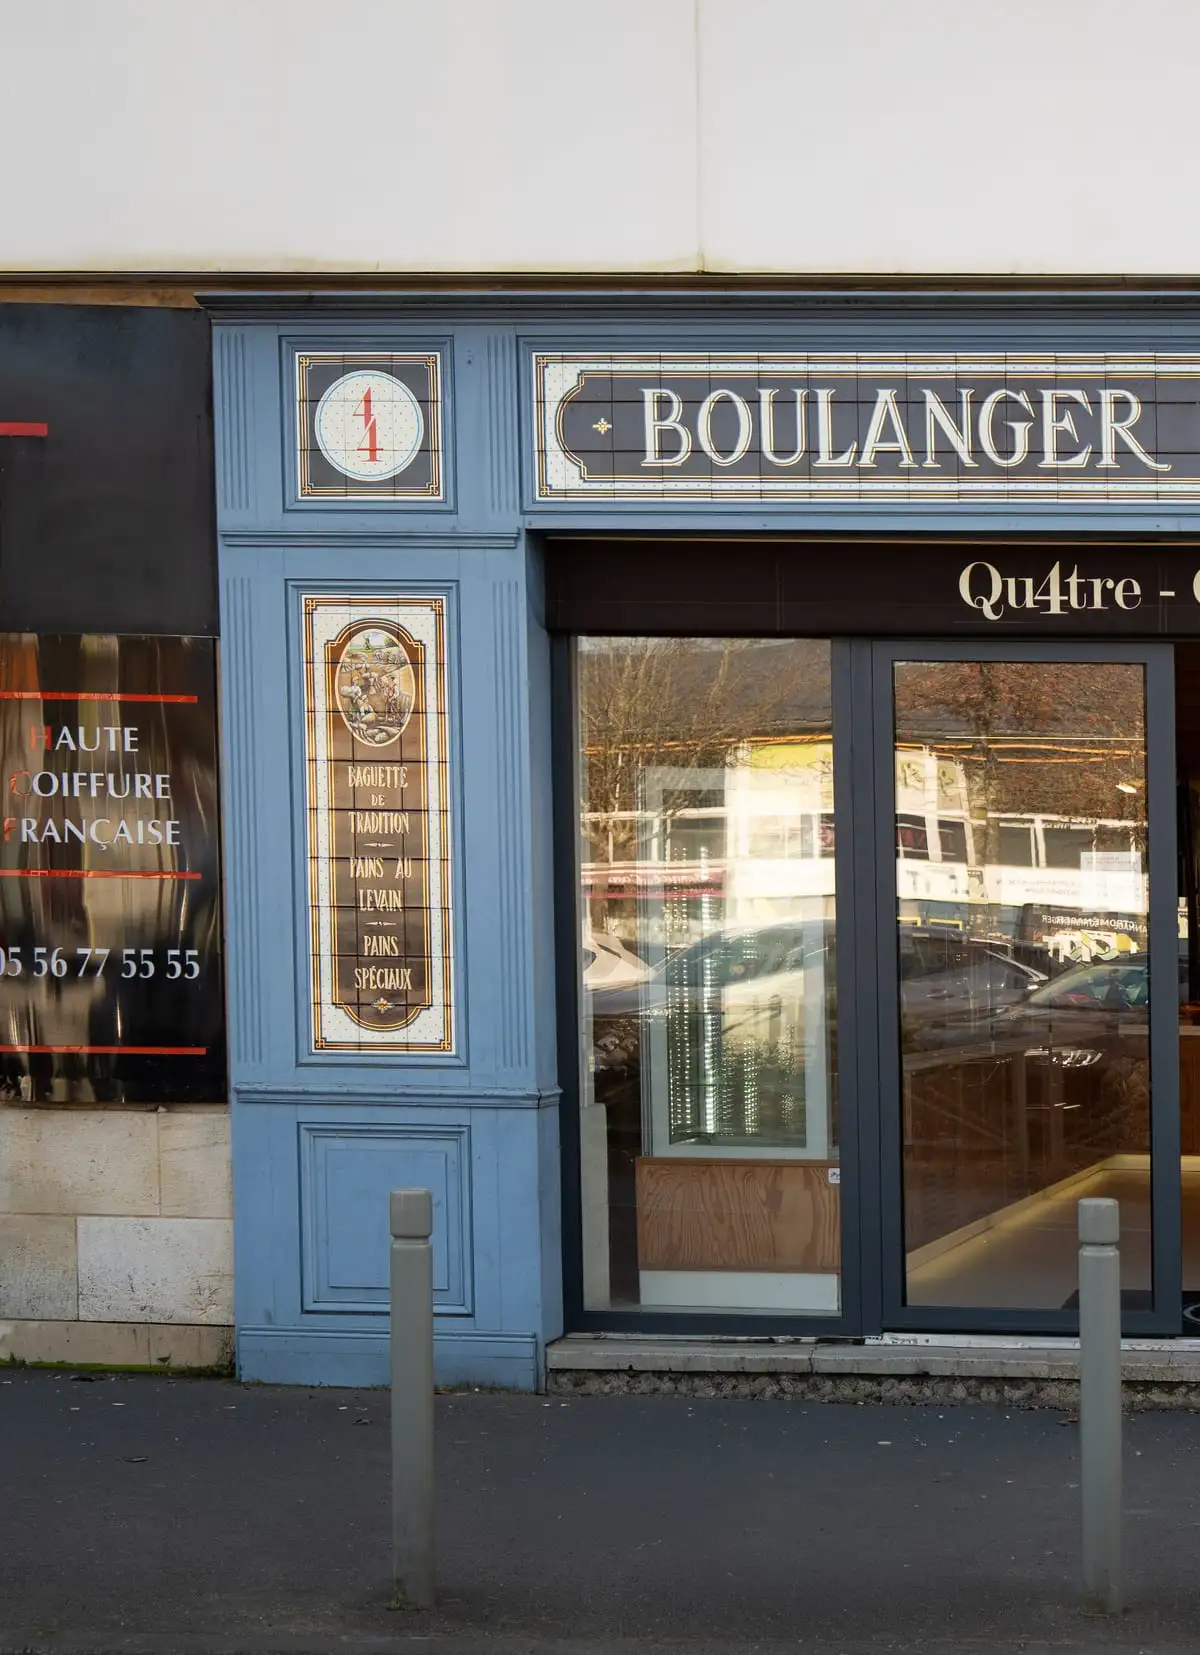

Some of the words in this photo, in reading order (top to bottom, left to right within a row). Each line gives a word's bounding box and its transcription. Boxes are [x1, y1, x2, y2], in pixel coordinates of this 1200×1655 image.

[641, 388, 1172, 472] BOULANGER
[958, 560, 1142, 621] Qu4tre
[30, 725, 139, 752] HAUTE
[9, 770, 171, 800] COIFFURE
[348, 765, 408, 788] BAGUETTE
[371, 794, 386, 806] DE
[3, 817, 181, 850] FRANÇAISE
[348, 811, 410, 834] TRADITION
[350, 856, 384, 879] PAINS
[394, 857, 412, 879] AU
[359, 889, 403, 912] LEVAIN
[363, 935, 399, 957] PAINS
[33, 947, 68, 978] 56
[76, 948, 110, 977] 77
[121, 949, 155, 979] 55
[165, 950, 200, 980] 55
[354, 965, 412, 990] SPÉCIAUX
